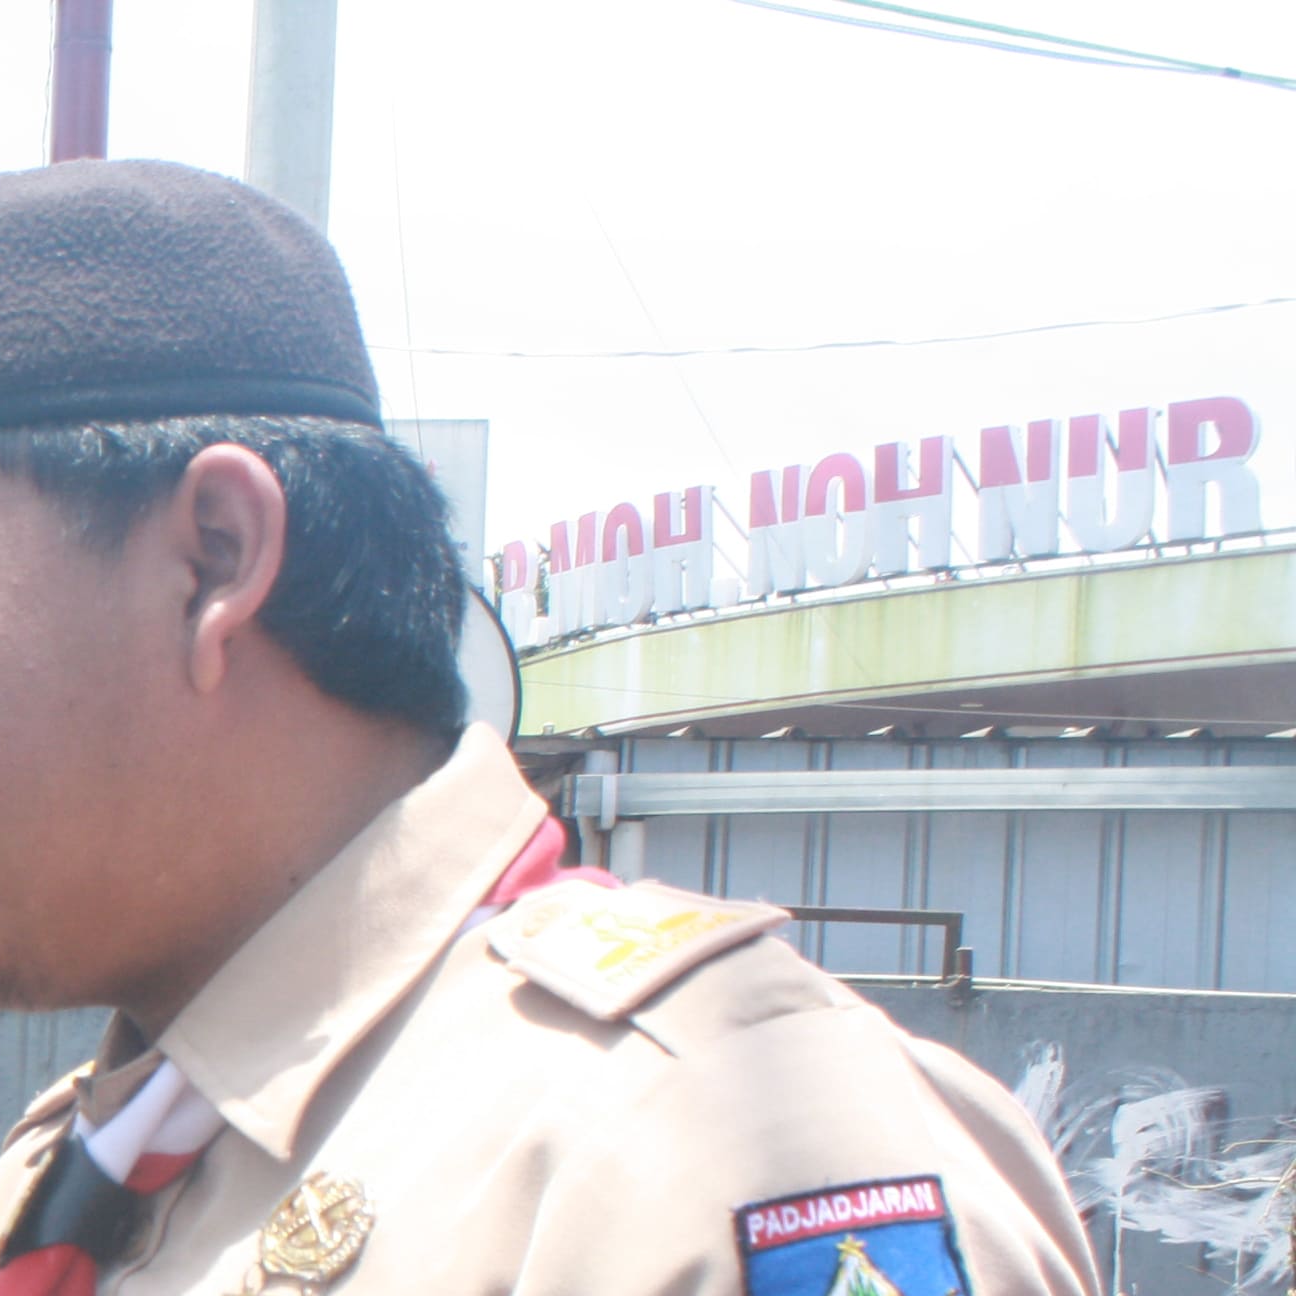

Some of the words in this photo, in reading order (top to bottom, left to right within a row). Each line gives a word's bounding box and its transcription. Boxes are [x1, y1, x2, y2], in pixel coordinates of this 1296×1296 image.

[748, 435, 953, 596] NOH
[978, 396, 1262, 561] NUR
[746, 1182, 936, 1244] PADJADJARAN
